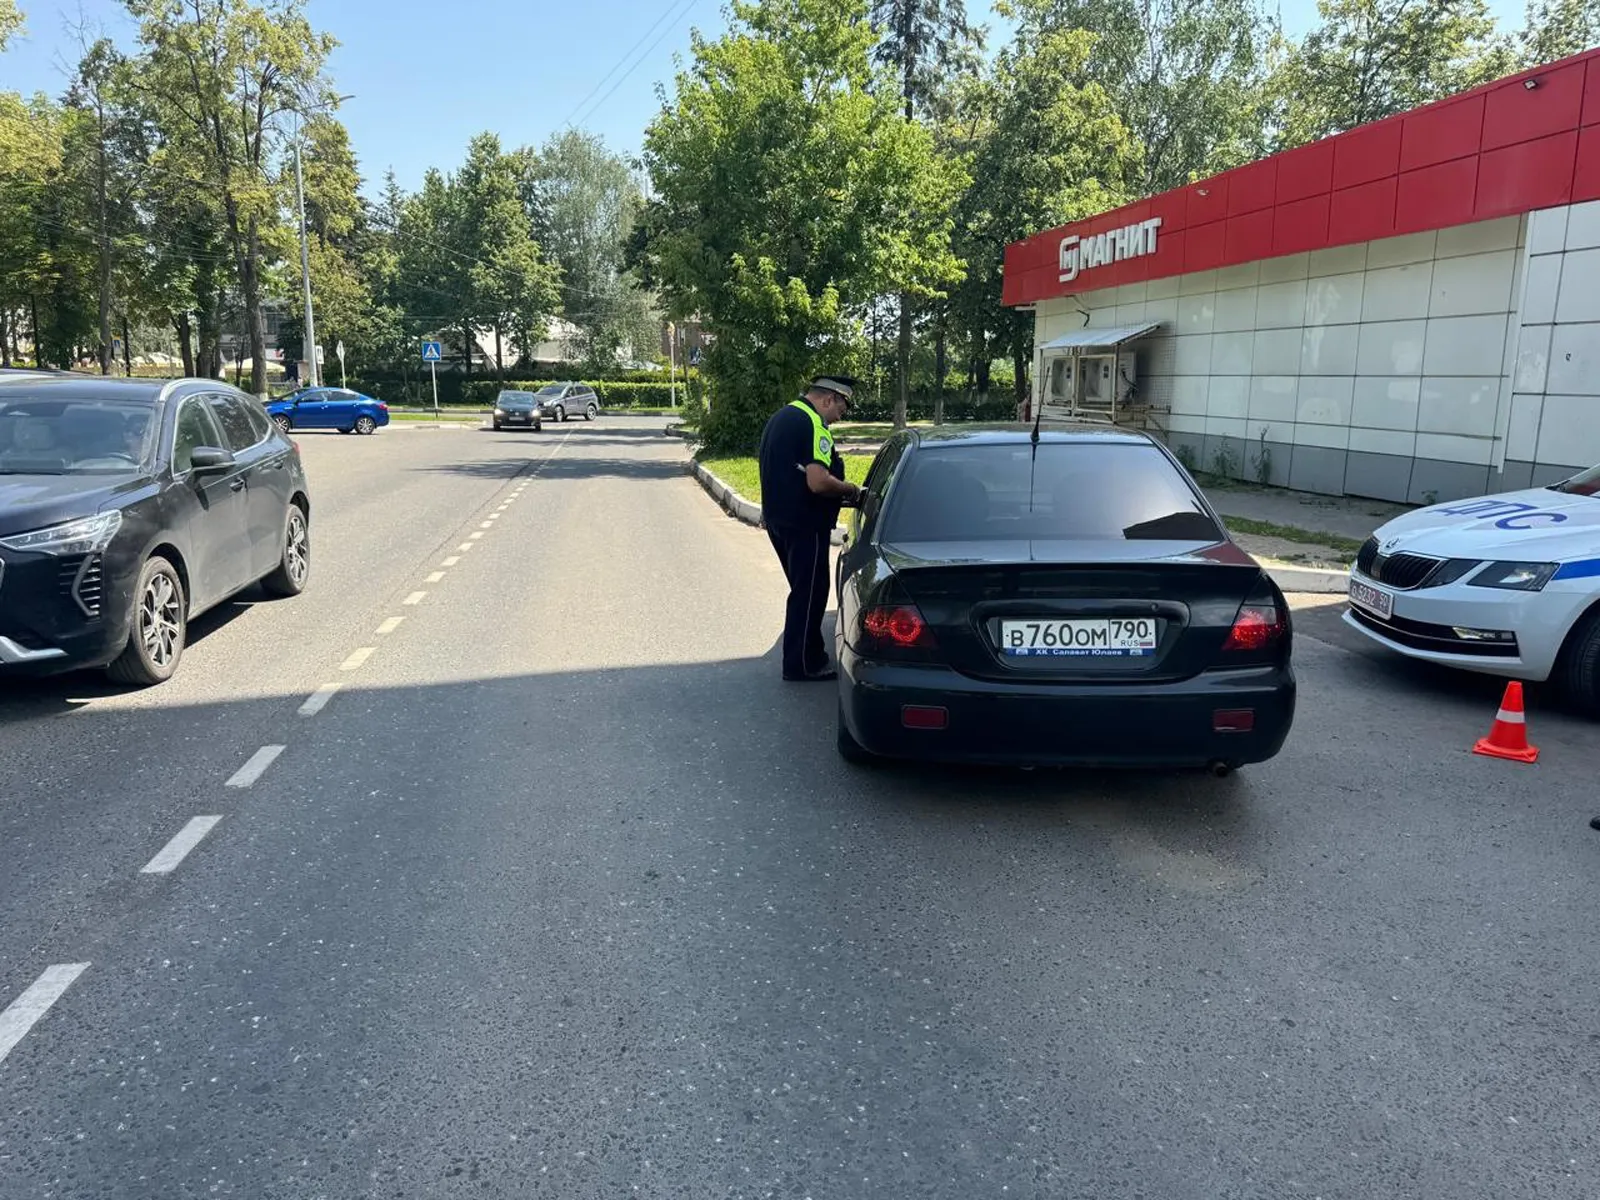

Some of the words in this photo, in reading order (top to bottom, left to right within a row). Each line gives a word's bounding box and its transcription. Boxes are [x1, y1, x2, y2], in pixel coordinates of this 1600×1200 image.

[1079, 217, 1162, 270] МАГНИТ
[1427, 500, 1568, 530] ДПС
[1010, 624, 1107, 647] В760ОМ
[1111, 620, 1149, 639] 790
[1120, 639, 1139, 647] RUS
